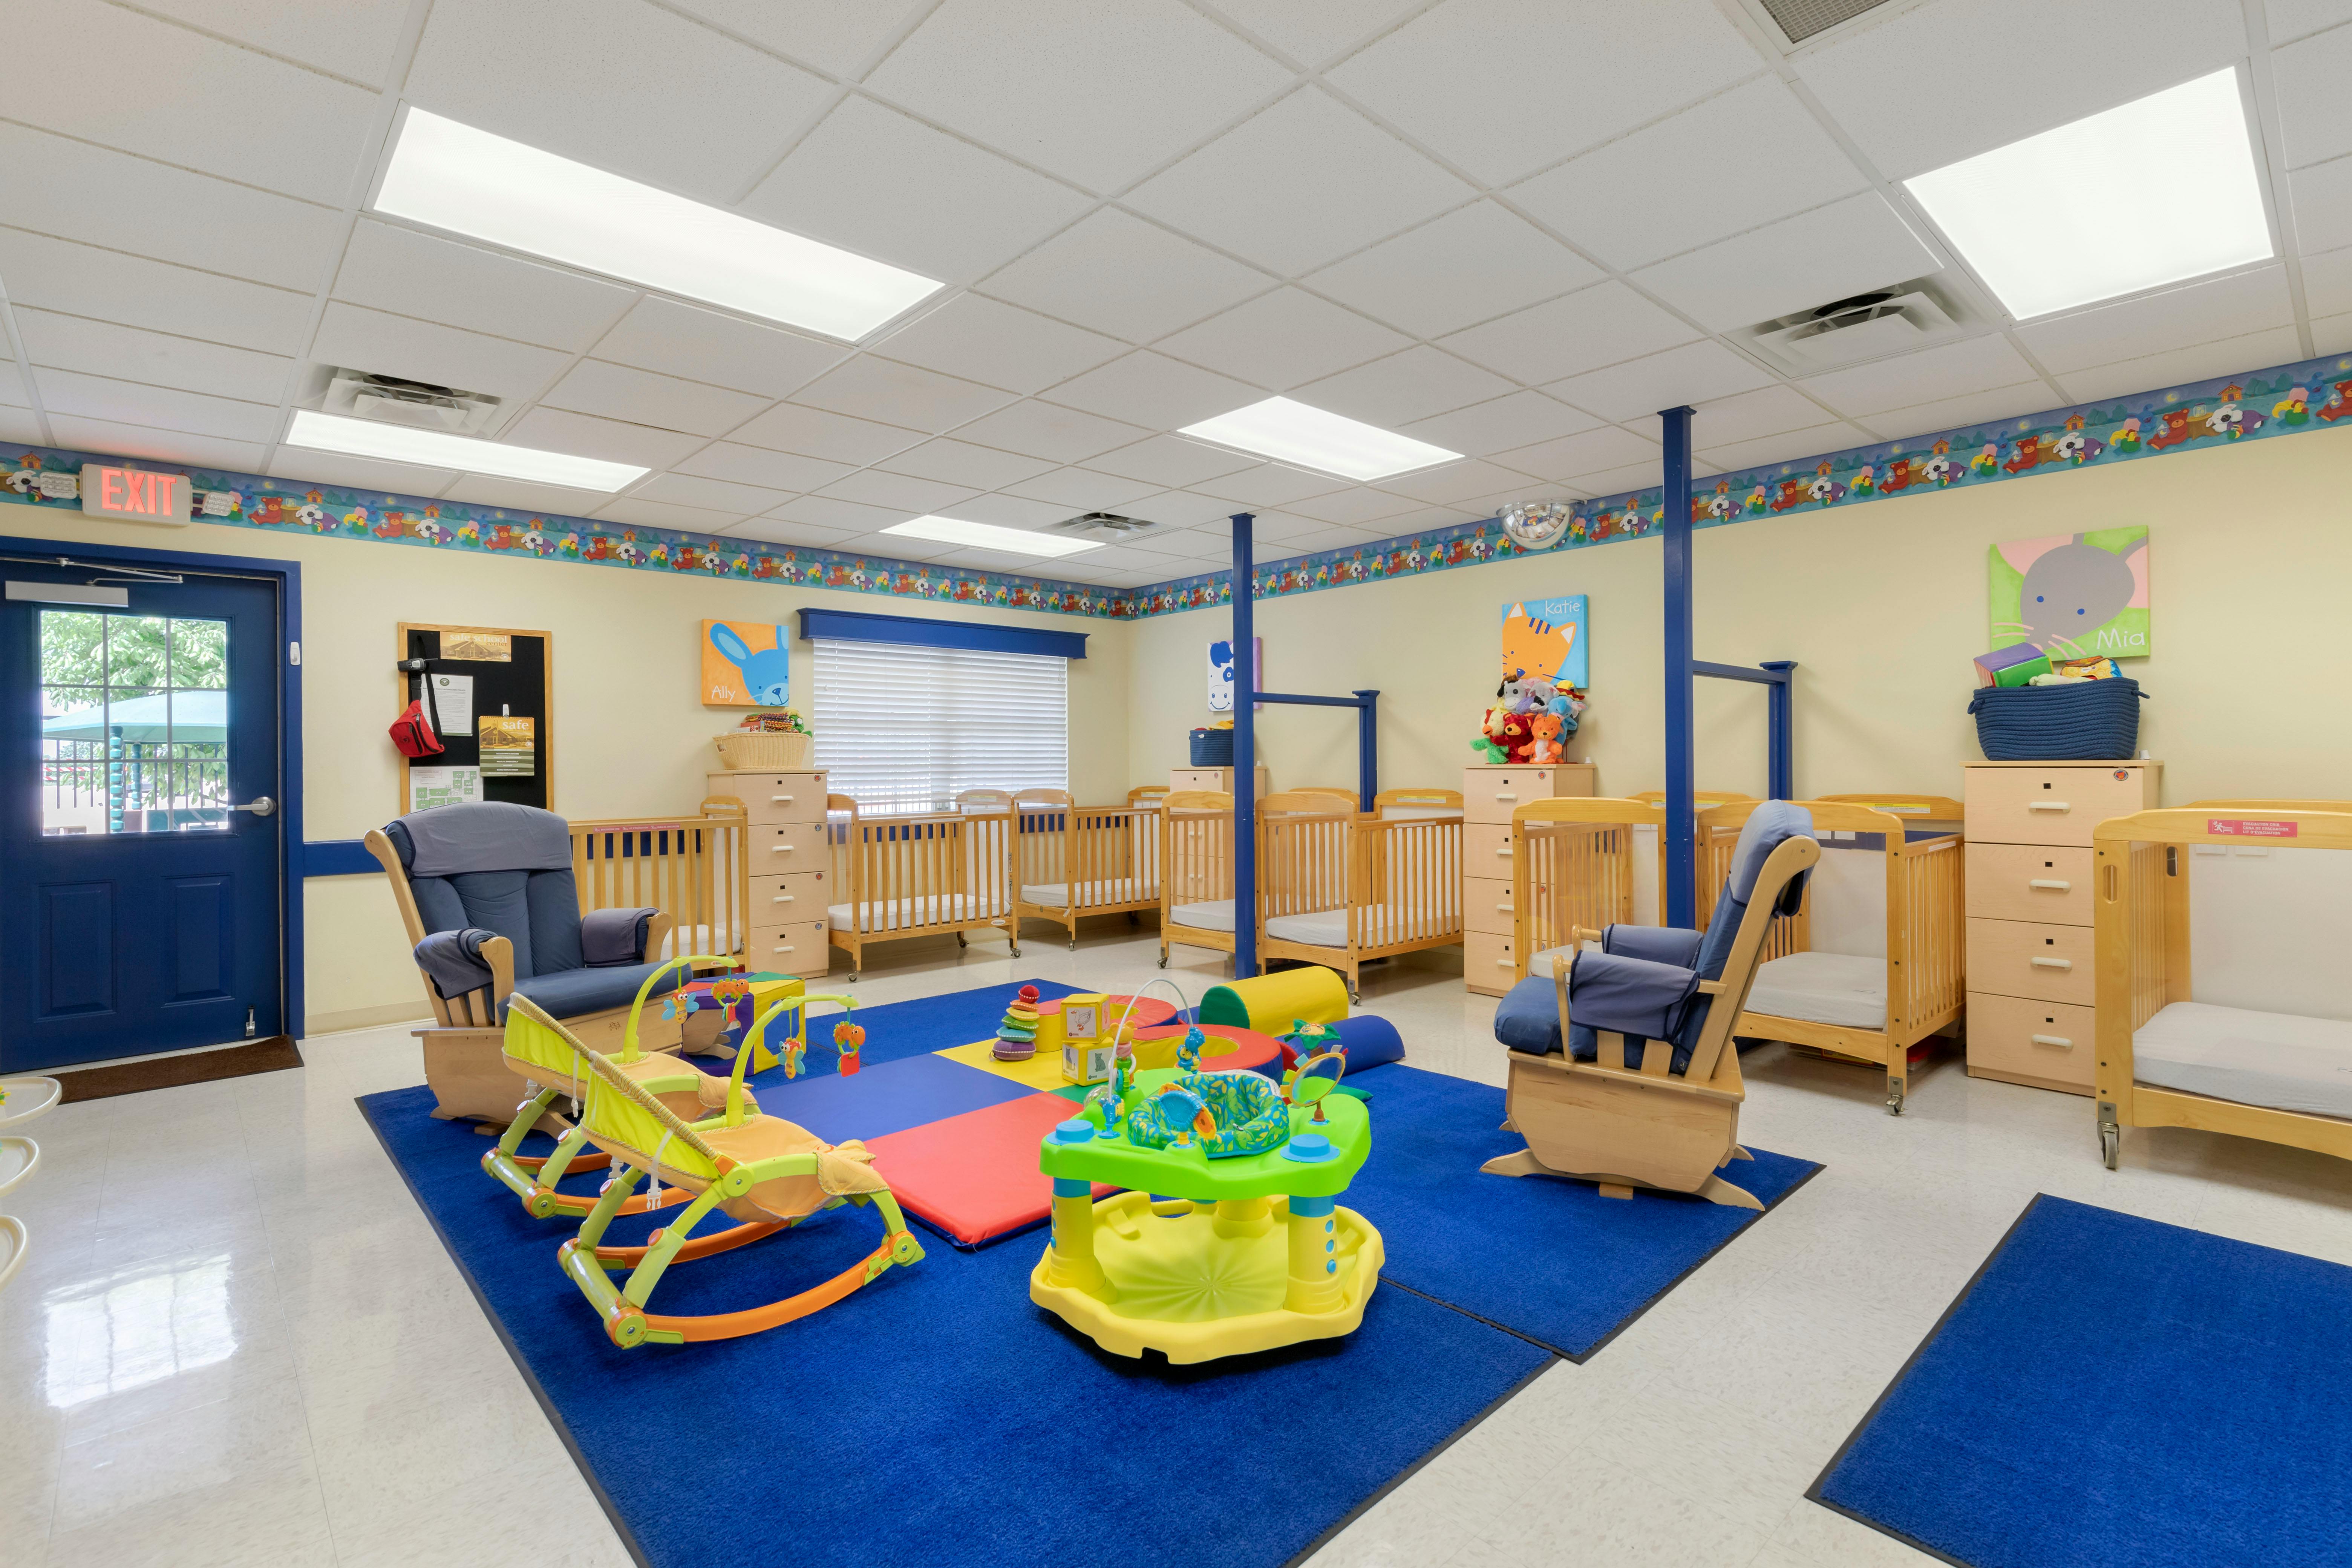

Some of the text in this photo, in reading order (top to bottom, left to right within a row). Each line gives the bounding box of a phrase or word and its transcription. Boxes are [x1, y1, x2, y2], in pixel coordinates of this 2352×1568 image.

[102, 469, 176, 516] EXIT
[1545, 600, 1580, 617] Katie
[473, 634, 507, 643] school
[2096, 628, 2145, 649] Mia
[711, 685, 736, 702] Ally
[502, 720, 529, 730] safe
